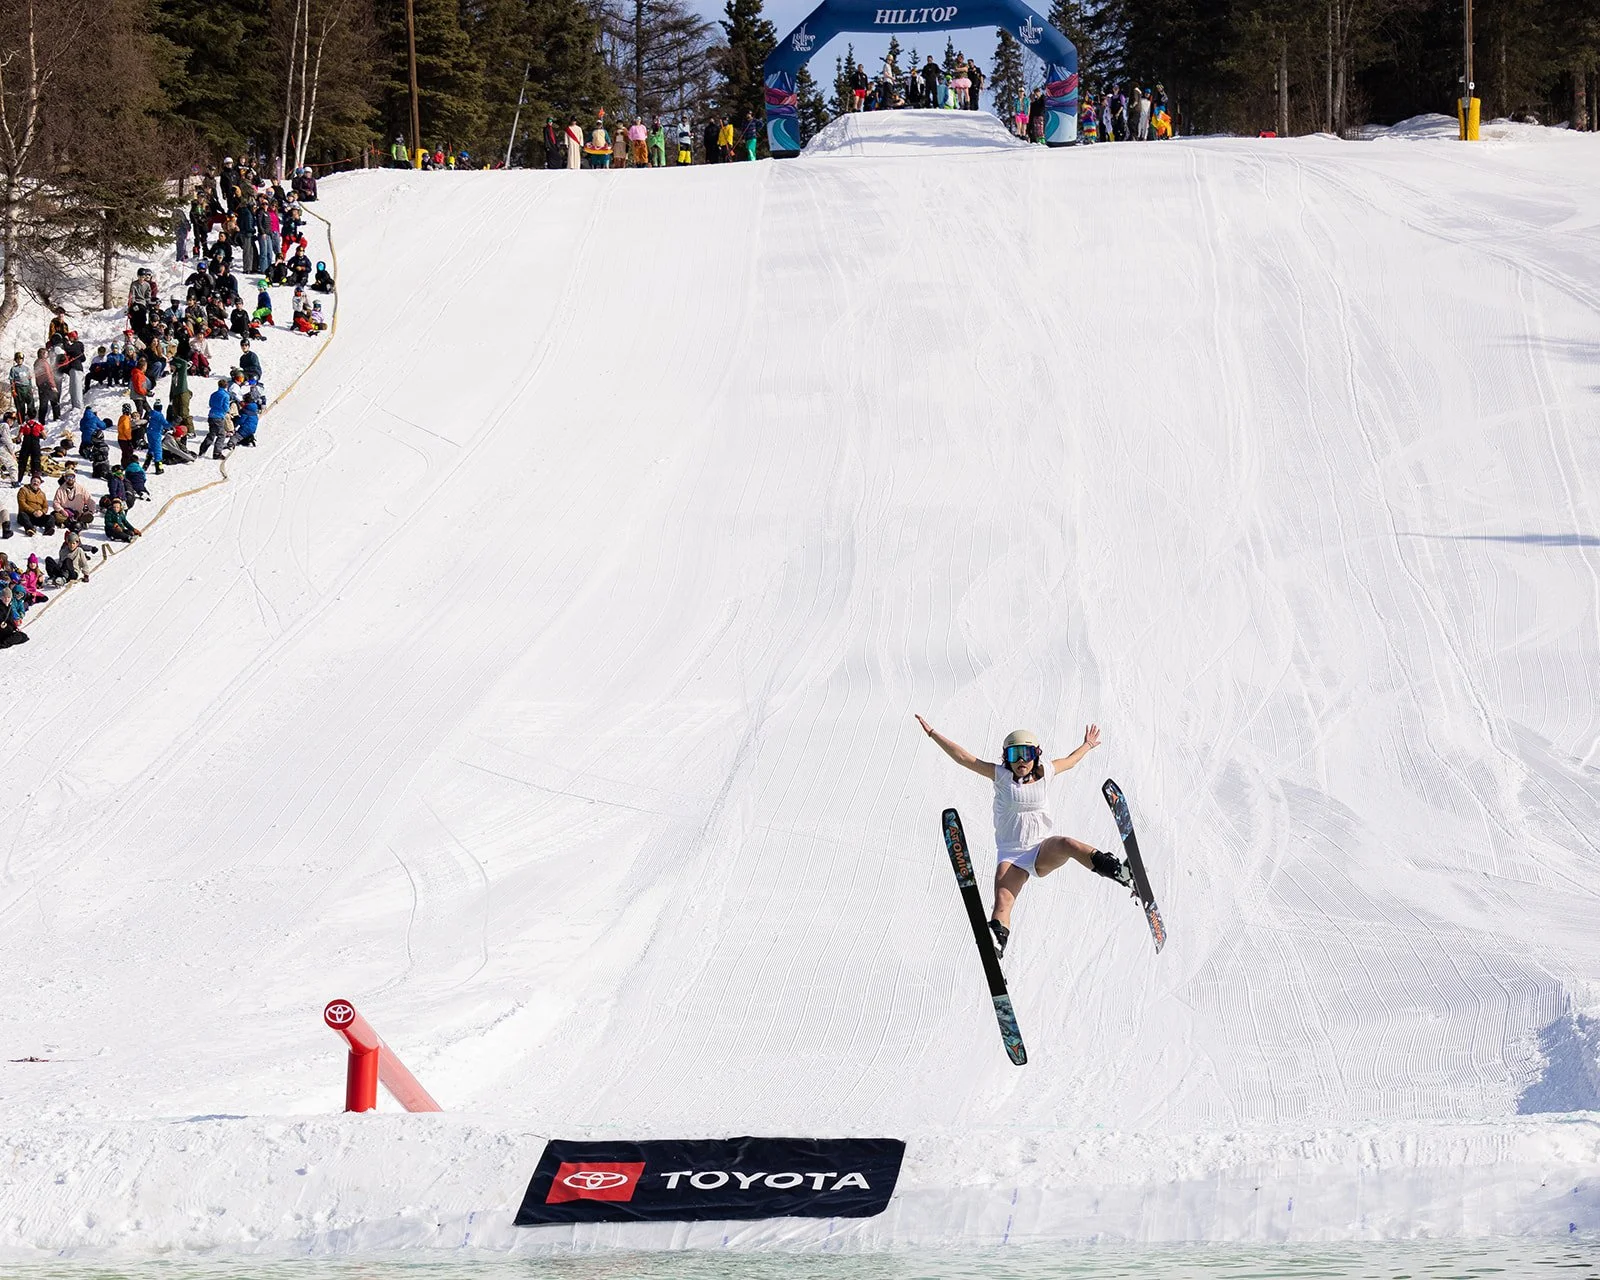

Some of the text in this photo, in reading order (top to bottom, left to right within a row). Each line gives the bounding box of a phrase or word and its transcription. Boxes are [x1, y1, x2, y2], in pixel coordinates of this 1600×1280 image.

[874, 6, 958, 24] HILLTOP
[949, 826, 969, 877] ATOMIC
[660, 1170, 871, 1191] TOYOTA
